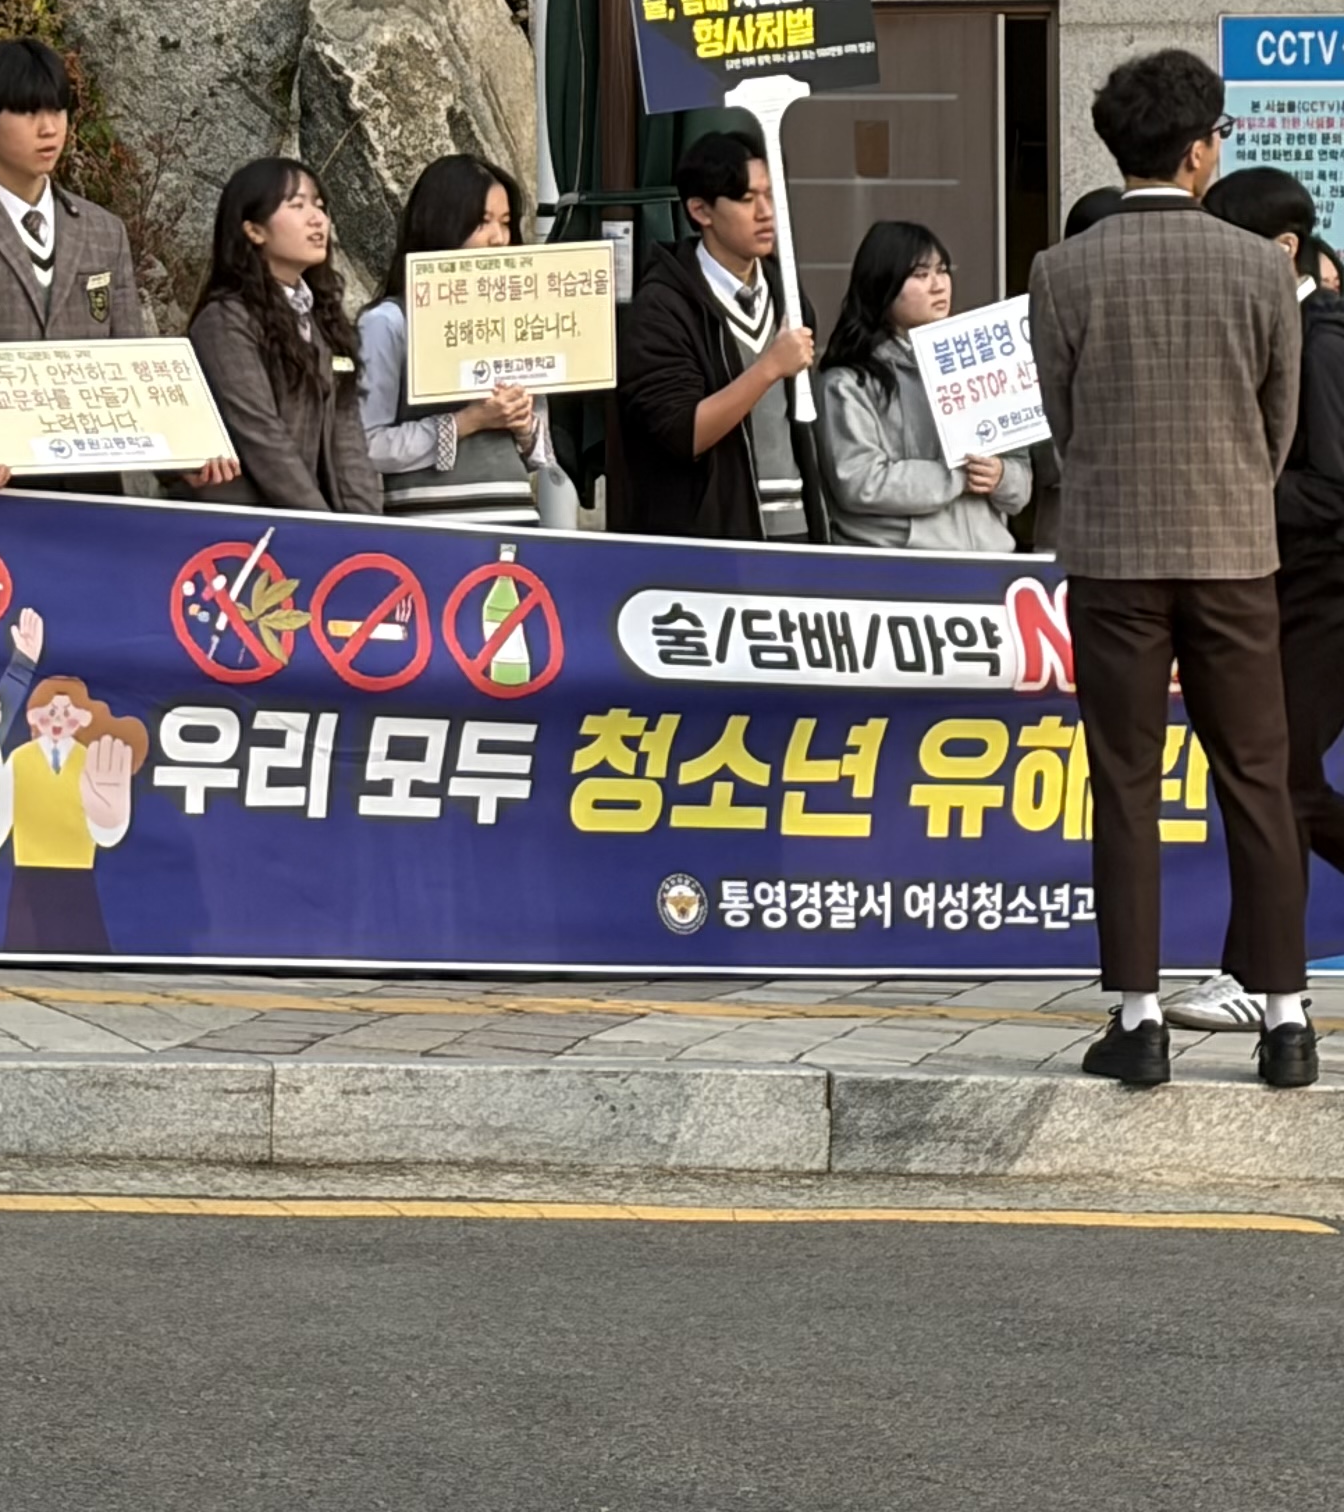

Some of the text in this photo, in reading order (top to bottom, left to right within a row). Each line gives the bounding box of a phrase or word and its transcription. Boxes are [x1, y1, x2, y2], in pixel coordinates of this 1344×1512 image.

[692, 7, 815, 58] 형사처벌
[1256, 30, 1339, 66] CCTV
[437, 269, 610, 306] 다른 학생들의 학습권을
[443, 311, 582, 348] 침해하지 않습니다.
[932, 319, 1016, 376] 불법촬영
[46, 361, 127, 386] 안전하고
[132, 359, 193, 382] 행복한
[79, 386, 142, 411] 만들기
[148, 384, 190, 407] 위해
[936, 382, 967, 416] 공유
[39, 411, 145, 435] 노력합니다.
[651, 579, 1075, 690] 술/담배/마약 N
[153, 705, 338, 820] 우리
[356, 715, 540, 826] 모두
[568, 705, 890, 838] 청소년
[718, 876, 892, 930] 통영경찰서
